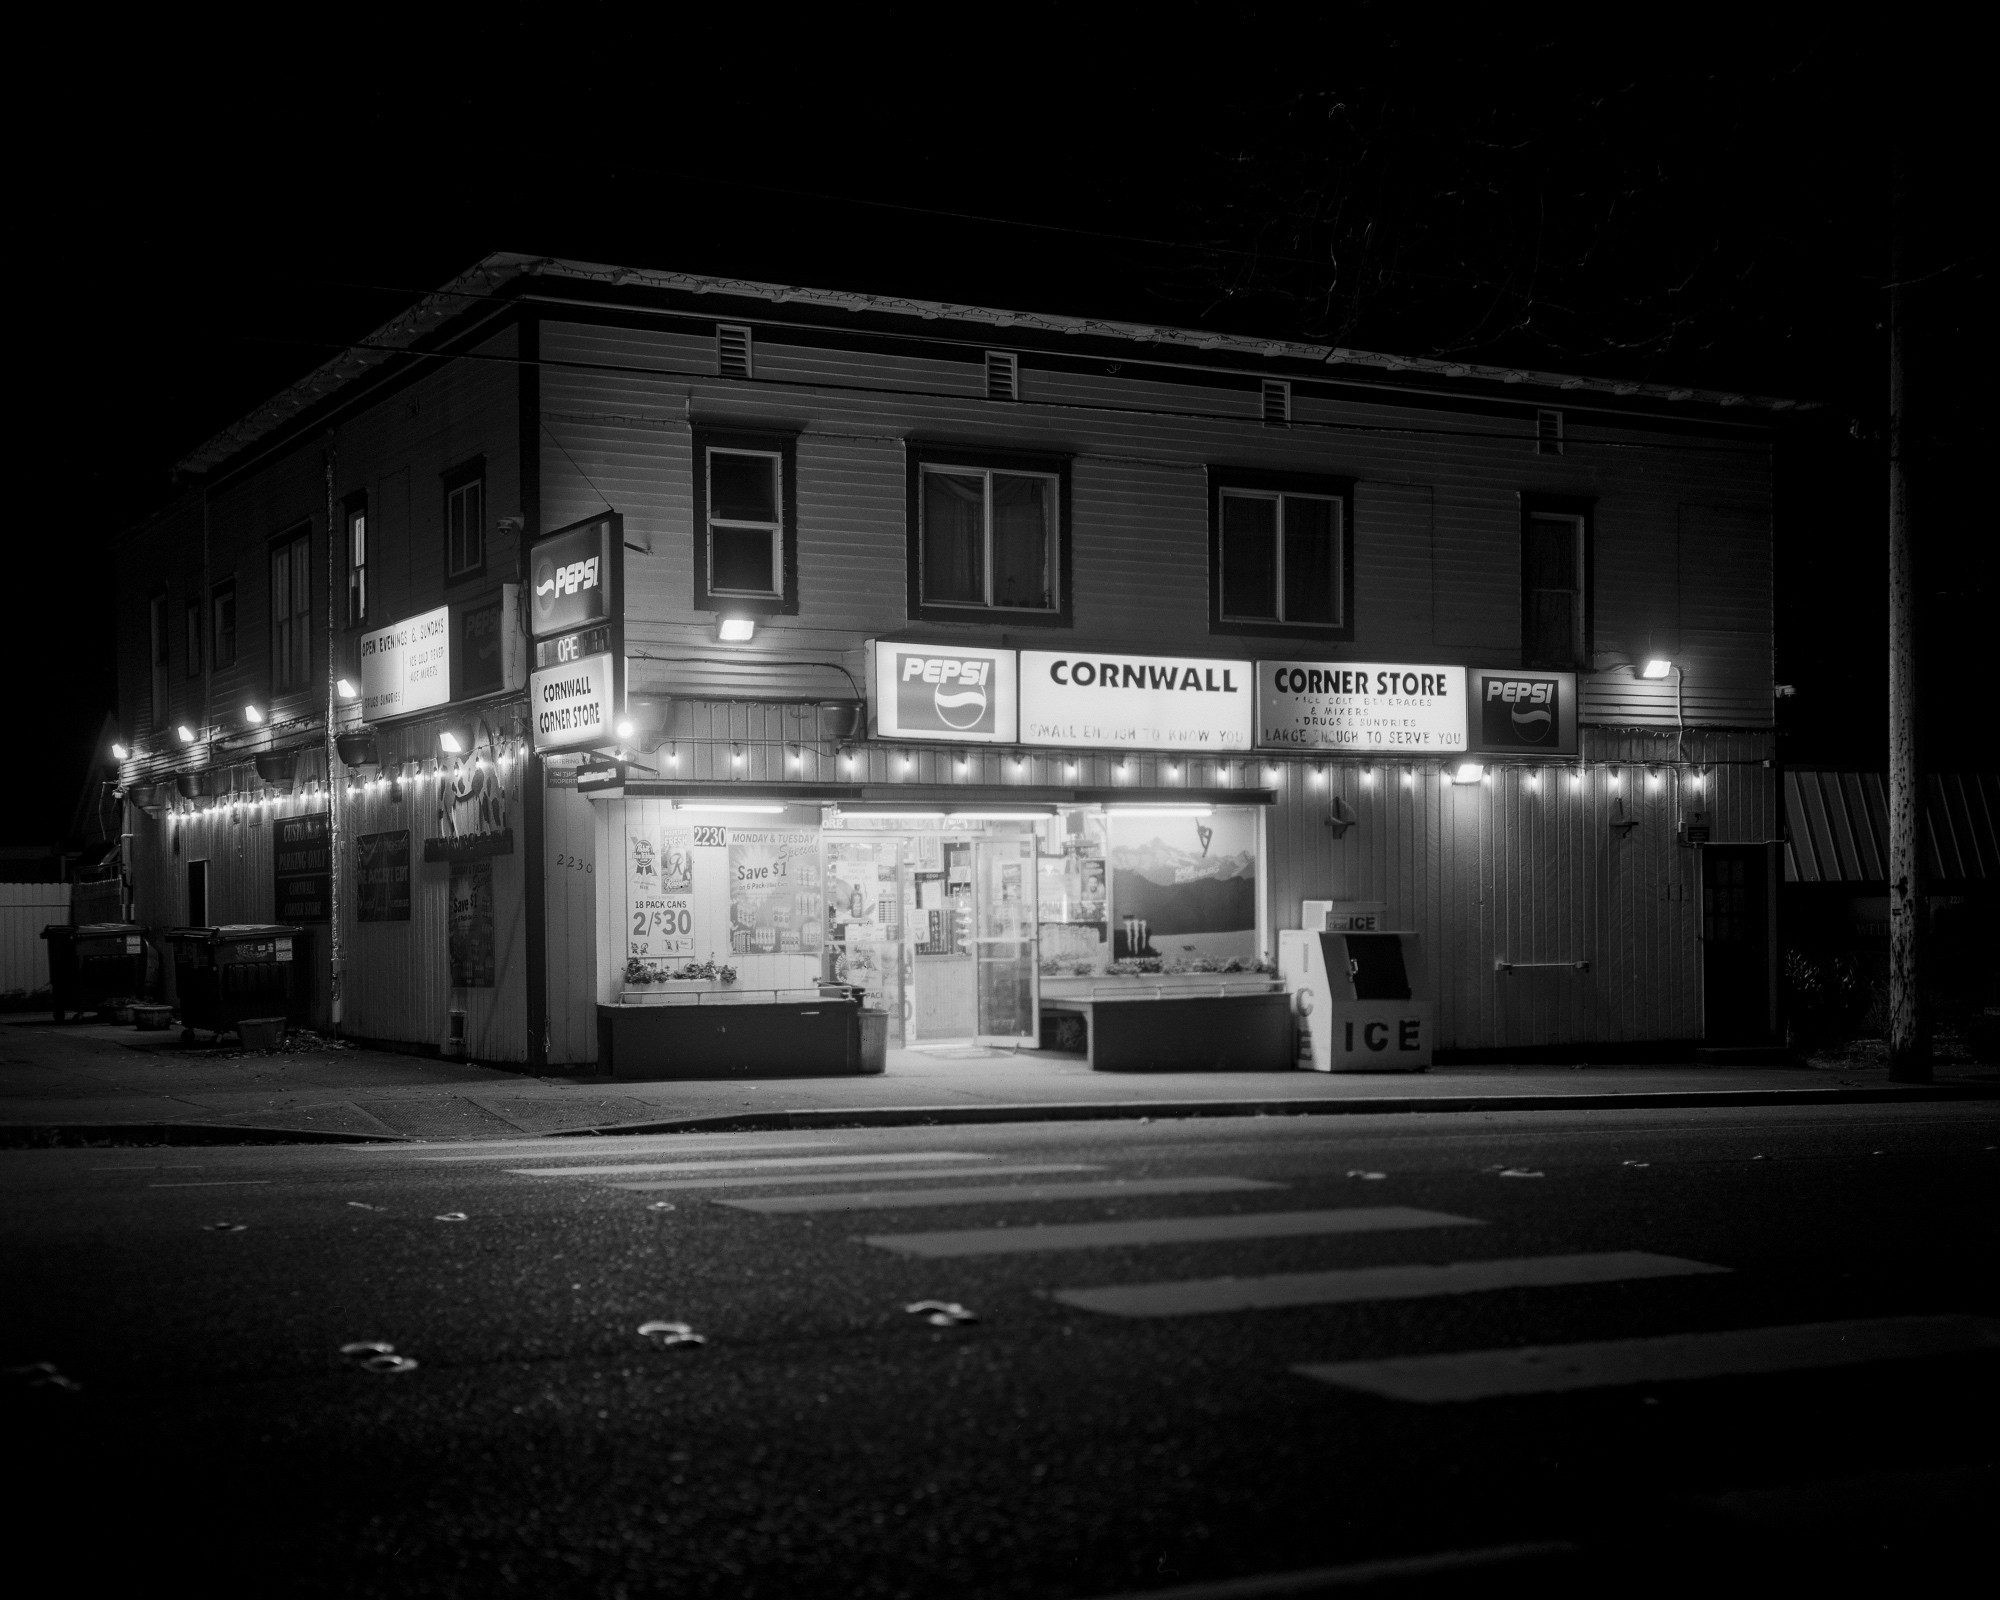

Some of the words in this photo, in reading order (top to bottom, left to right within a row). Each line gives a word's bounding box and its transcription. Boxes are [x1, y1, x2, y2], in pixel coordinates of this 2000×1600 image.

[555, 556, 599, 598] PEPSI
[362, 639, 377, 657] OPEN
[380, 631, 407, 653] EVENINGS
[902, 657, 990, 686] PEPSI
[1050, 660, 1239, 693] CORNWALL
[1275, 667, 1369, 694] CORNER
[1376, 671, 1447, 696] STORE
[543, 676, 592, 703] CORNWALL
[1486, 681, 1554, 704] PEPSI
[1311, 706, 1317, 716] &
[1324, 707, 1369, 716] MIXERS
[1365, 698, 1432, 707] BEERAGES
[539, 707, 571, 734] CORNER
[573, 702, 600, 728] STORE
[1304, 716, 1342, 726] DRUGS
[1359, 718, 1416, 728] SUNDRIES
[1083, 725, 1136, 740] ENGH
[1265, 729, 1307, 742] LARGE
[1367, 731, 1382, 744] TO
[1389, 731, 1431, 744] SERVE
[1438, 732, 1462, 745] YOU
[694, 827, 726, 846] 2230
[732, 833, 768, 843] MONDAY
[770, 833, 776, 843] &
[779, 833, 814, 844] TUESDAY
[556, 853, 593, 873] 2230
[737, 864, 769, 881] Save
[773, 861, 787, 877] $1
[453, 897, 469, 913] Save
[635, 901, 644, 909] 18
[645, 901, 665, 909] PACK
[667, 900, 687, 909] CANS
[1349, 916, 1376, 930] ICE
[1345, 1020, 1421, 1052] ICE
